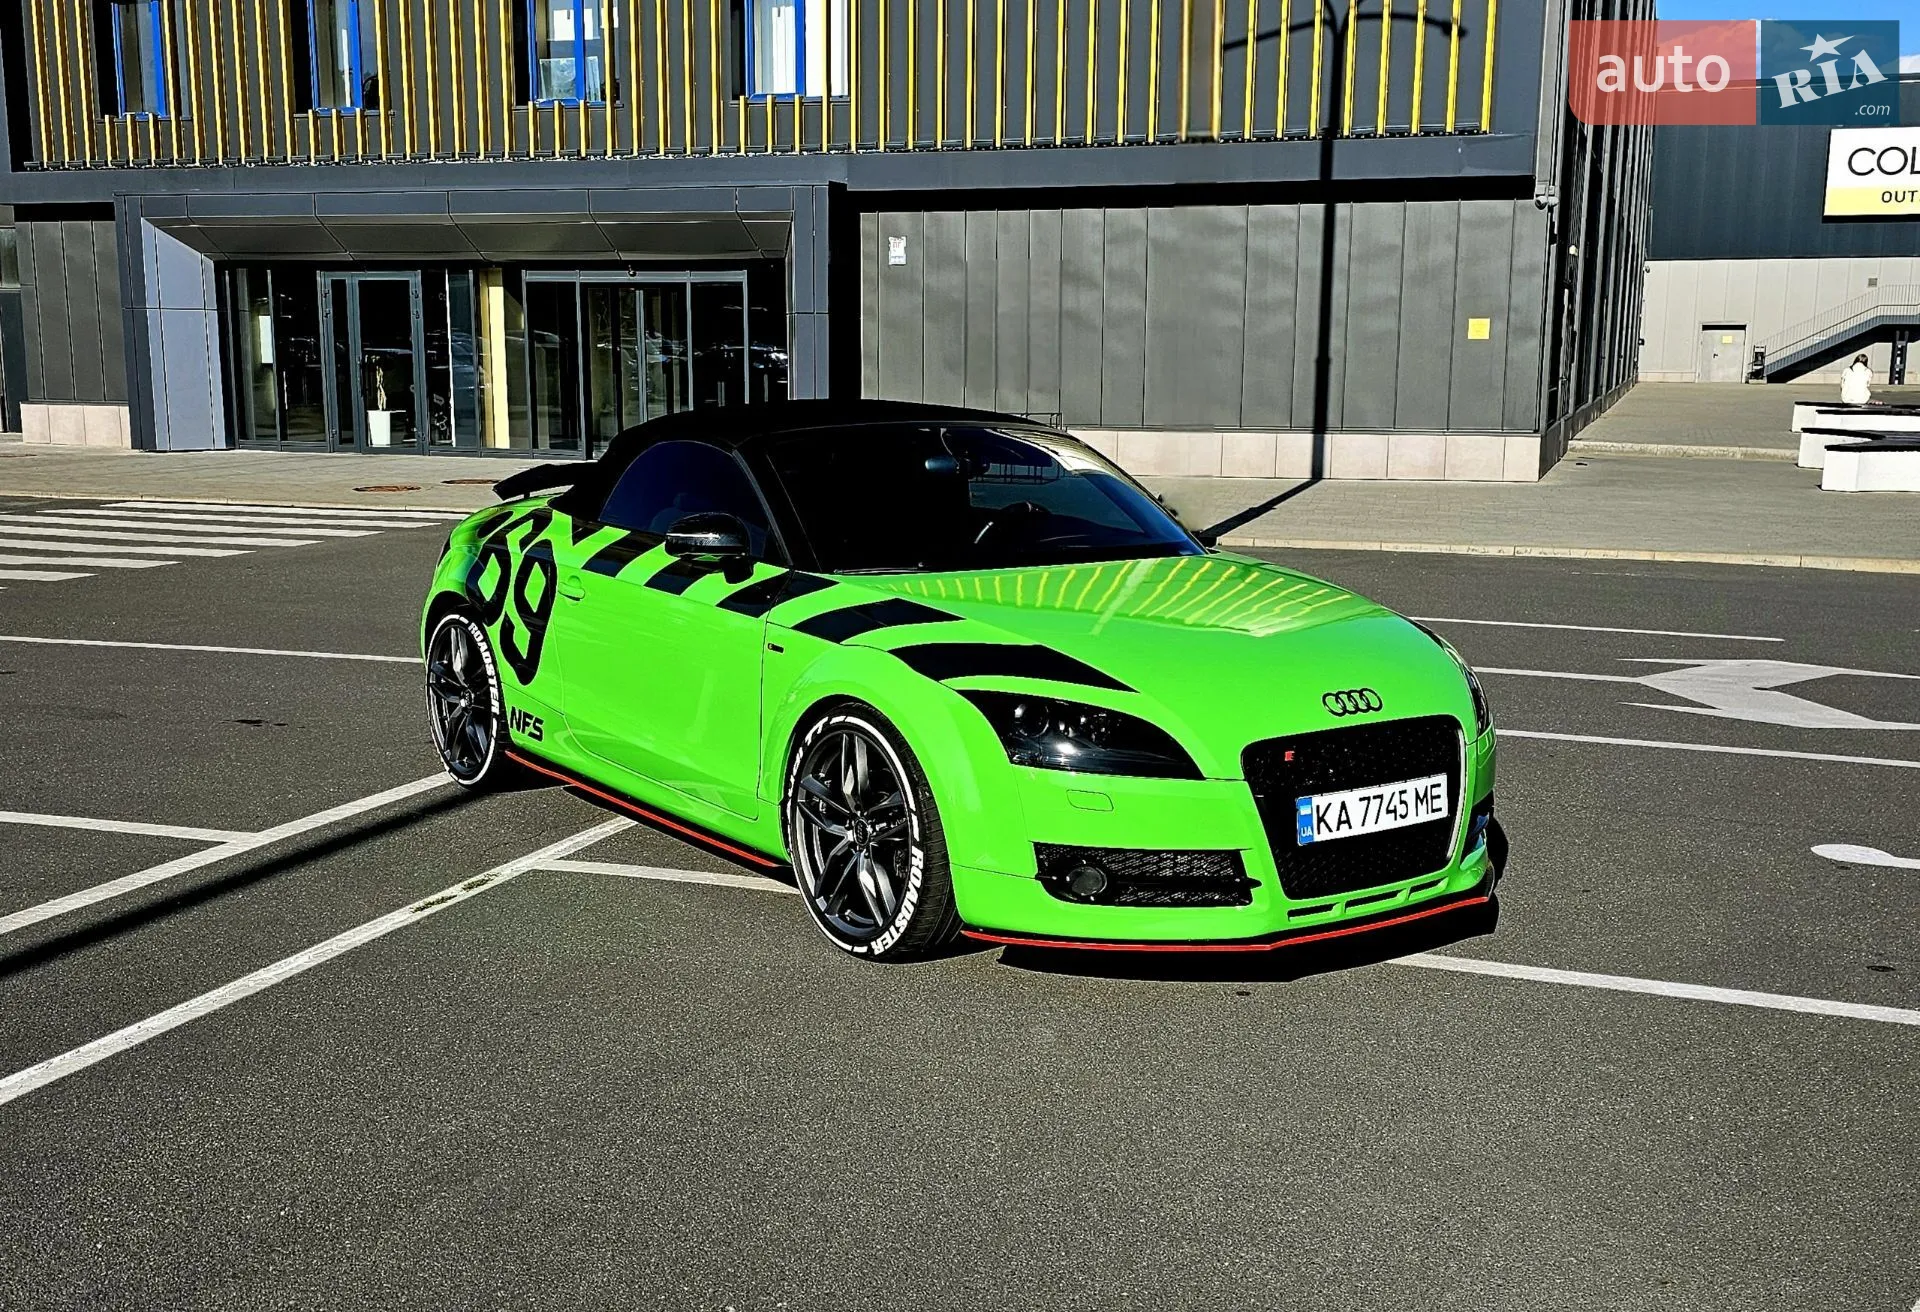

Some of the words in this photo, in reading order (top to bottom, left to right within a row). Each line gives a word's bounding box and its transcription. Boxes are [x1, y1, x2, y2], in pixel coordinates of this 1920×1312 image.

[1848, 146, 1920, 176] COL
[467, 622, 500, 715] ROADSTER
[510, 705, 544, 742] NFS
[1301, 826, 1313, 837] UA
[1316, 800, 1353, 836] KA
[1358, 789, 1409, 827] 7745
[1415, 783, 1443, 817] ME
[870, 845, 924, 955] ROADSTER
